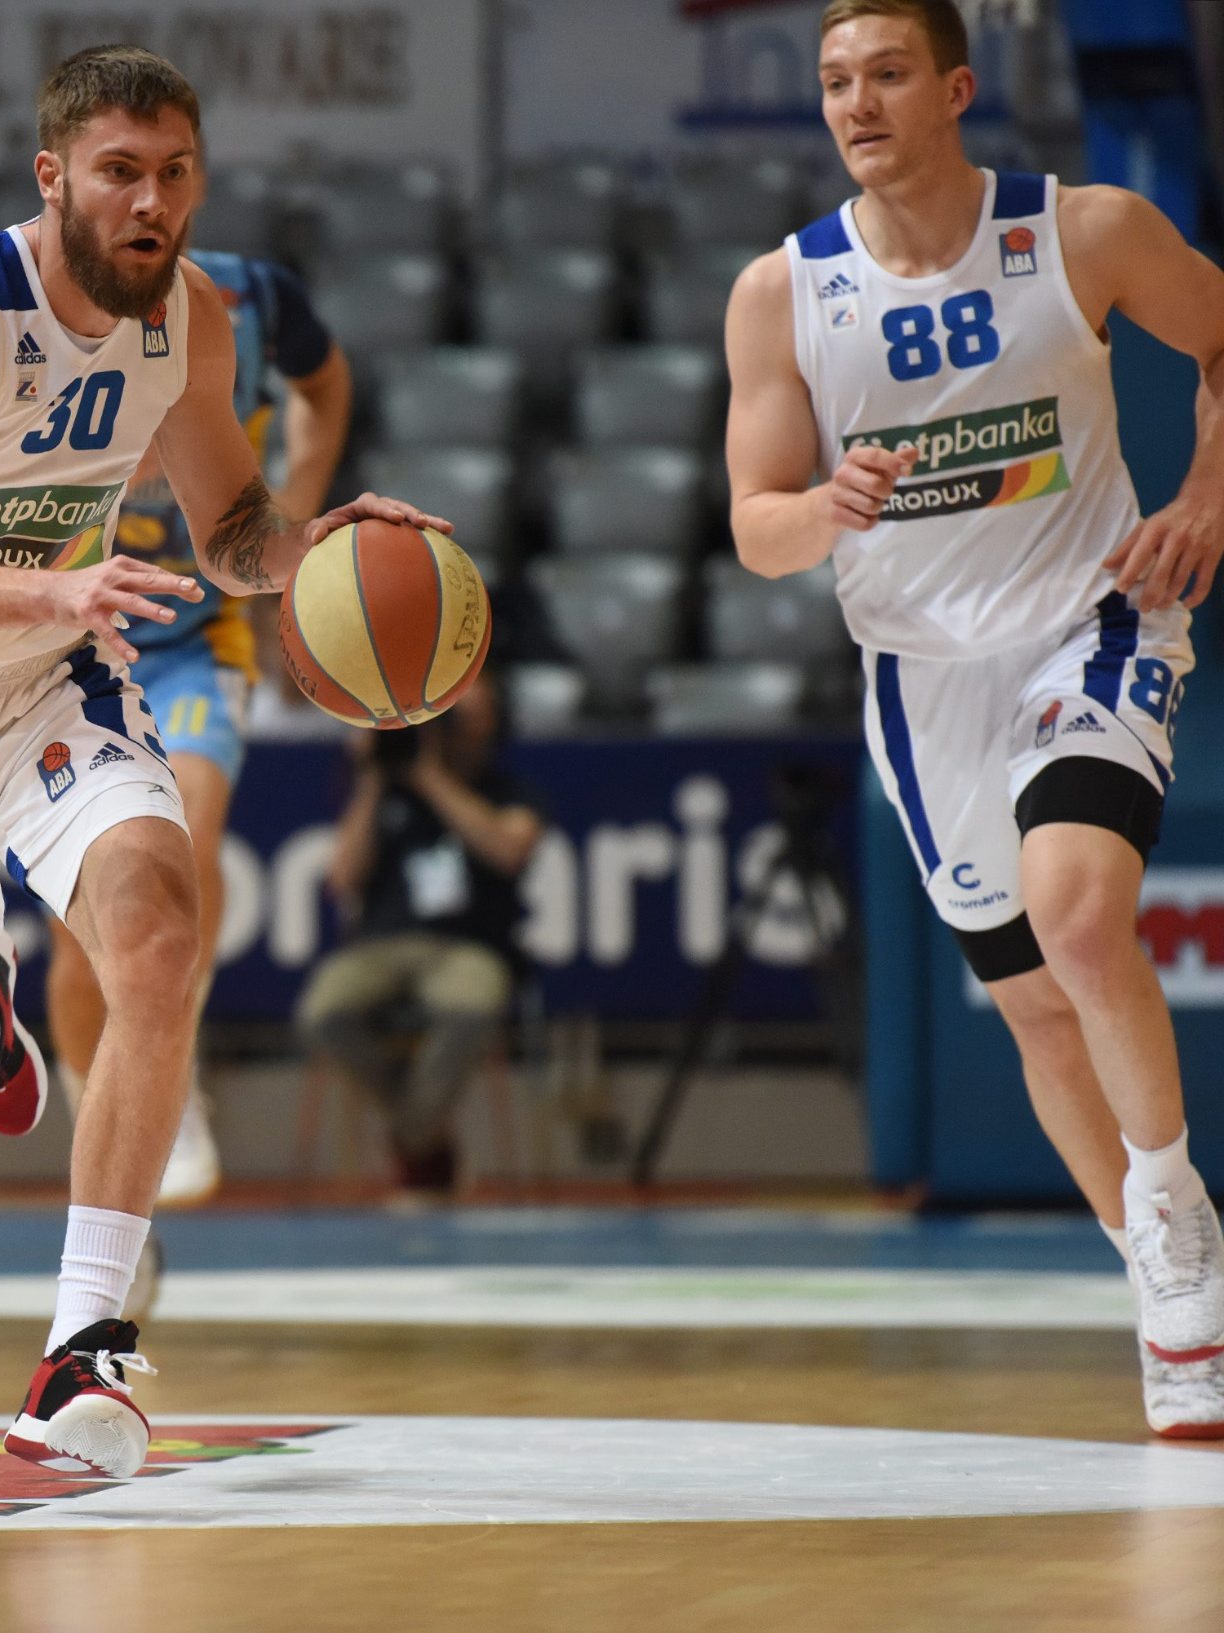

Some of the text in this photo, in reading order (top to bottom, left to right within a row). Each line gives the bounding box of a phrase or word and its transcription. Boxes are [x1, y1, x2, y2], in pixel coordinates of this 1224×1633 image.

[1004, 254, 1035, 276] ABA
[145, 330, 168, 354] ABA
[881, 289, 1000, 382] 88
[21, 370, 126, 454] 30
[882, 480, 982, 512] RODUX
[89, 752, 135, 771] adidas
[49, 766, 75, 799] ABA
